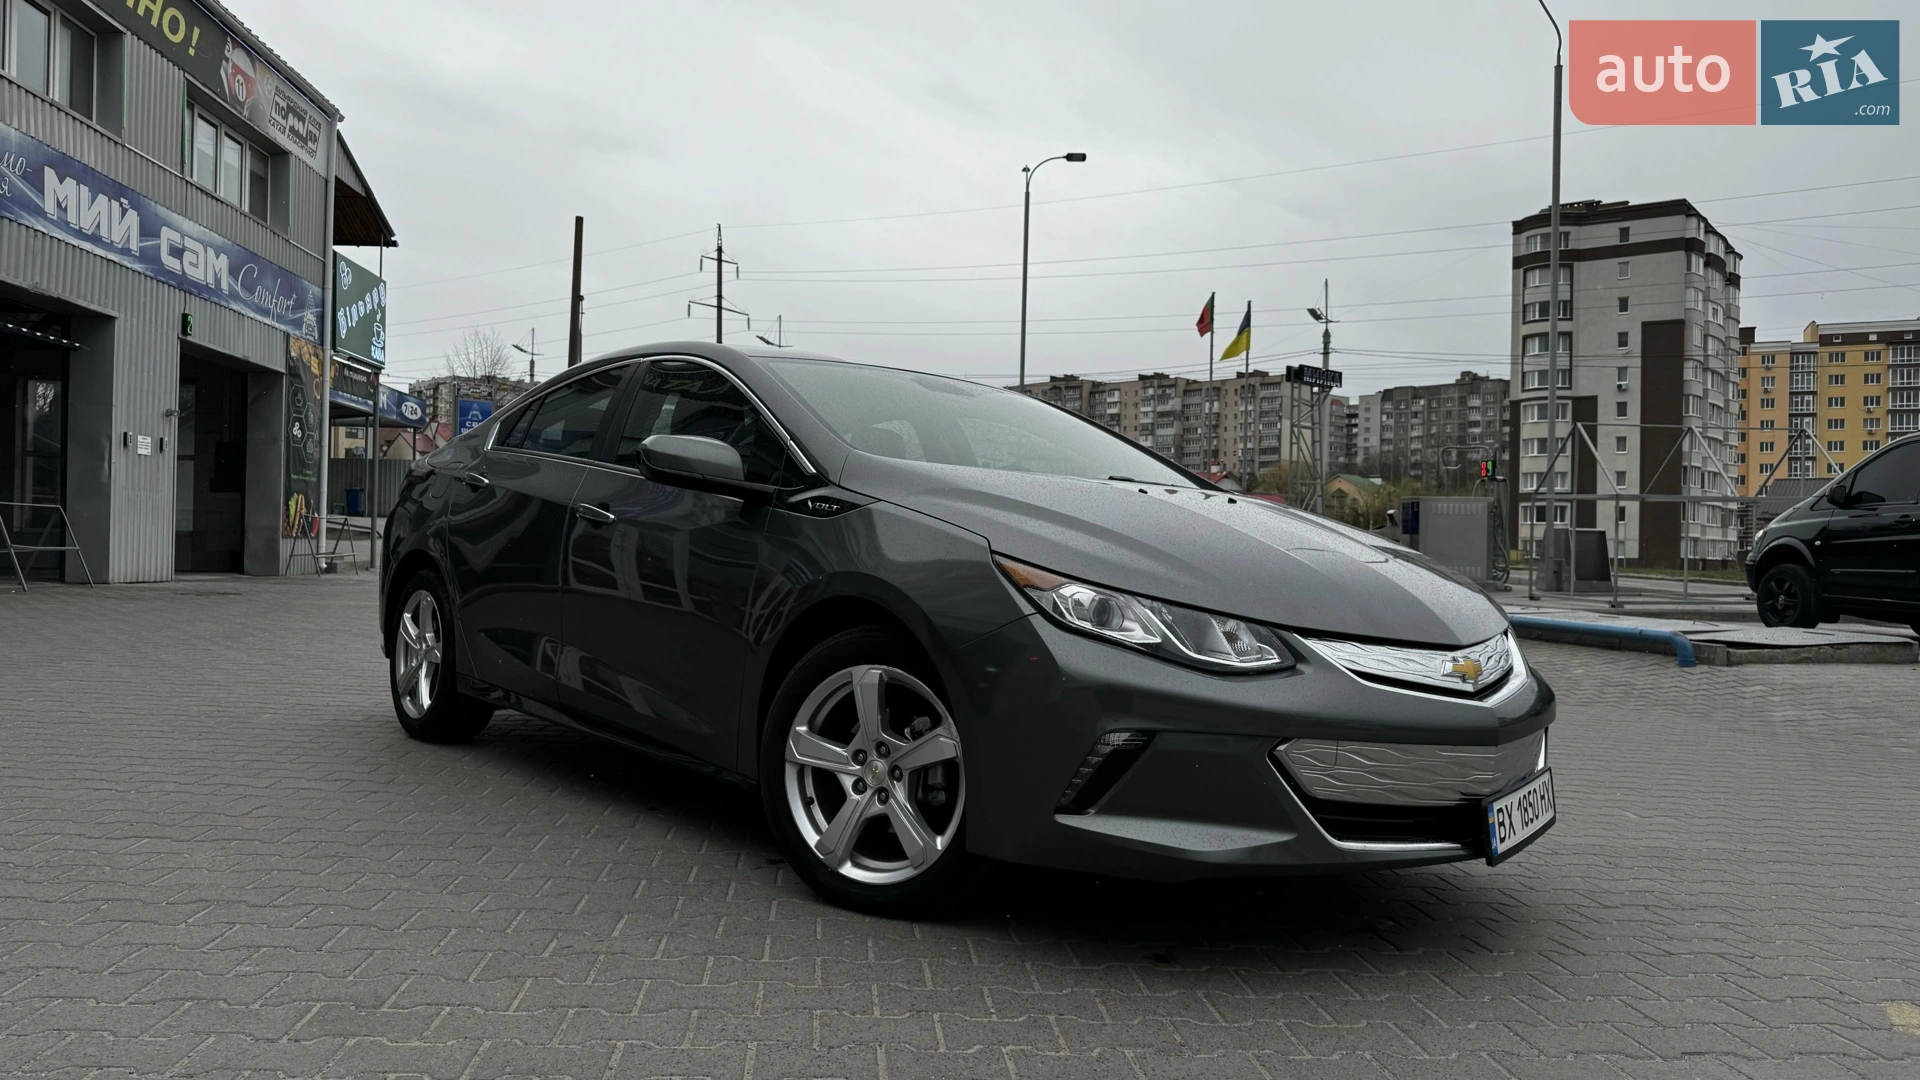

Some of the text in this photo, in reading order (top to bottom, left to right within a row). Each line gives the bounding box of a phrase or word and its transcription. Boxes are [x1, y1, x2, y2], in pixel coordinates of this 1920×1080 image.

[236, 78, 244, 100] 11
[44, 165, 140, 257] МИЙ
[238, 263, 297, 323] Comfort
[187, 315, 193, 334] 2
[808, 499, 840, 511] VOLT
[1496, 777, 1553, 844] BX 1850 HX
